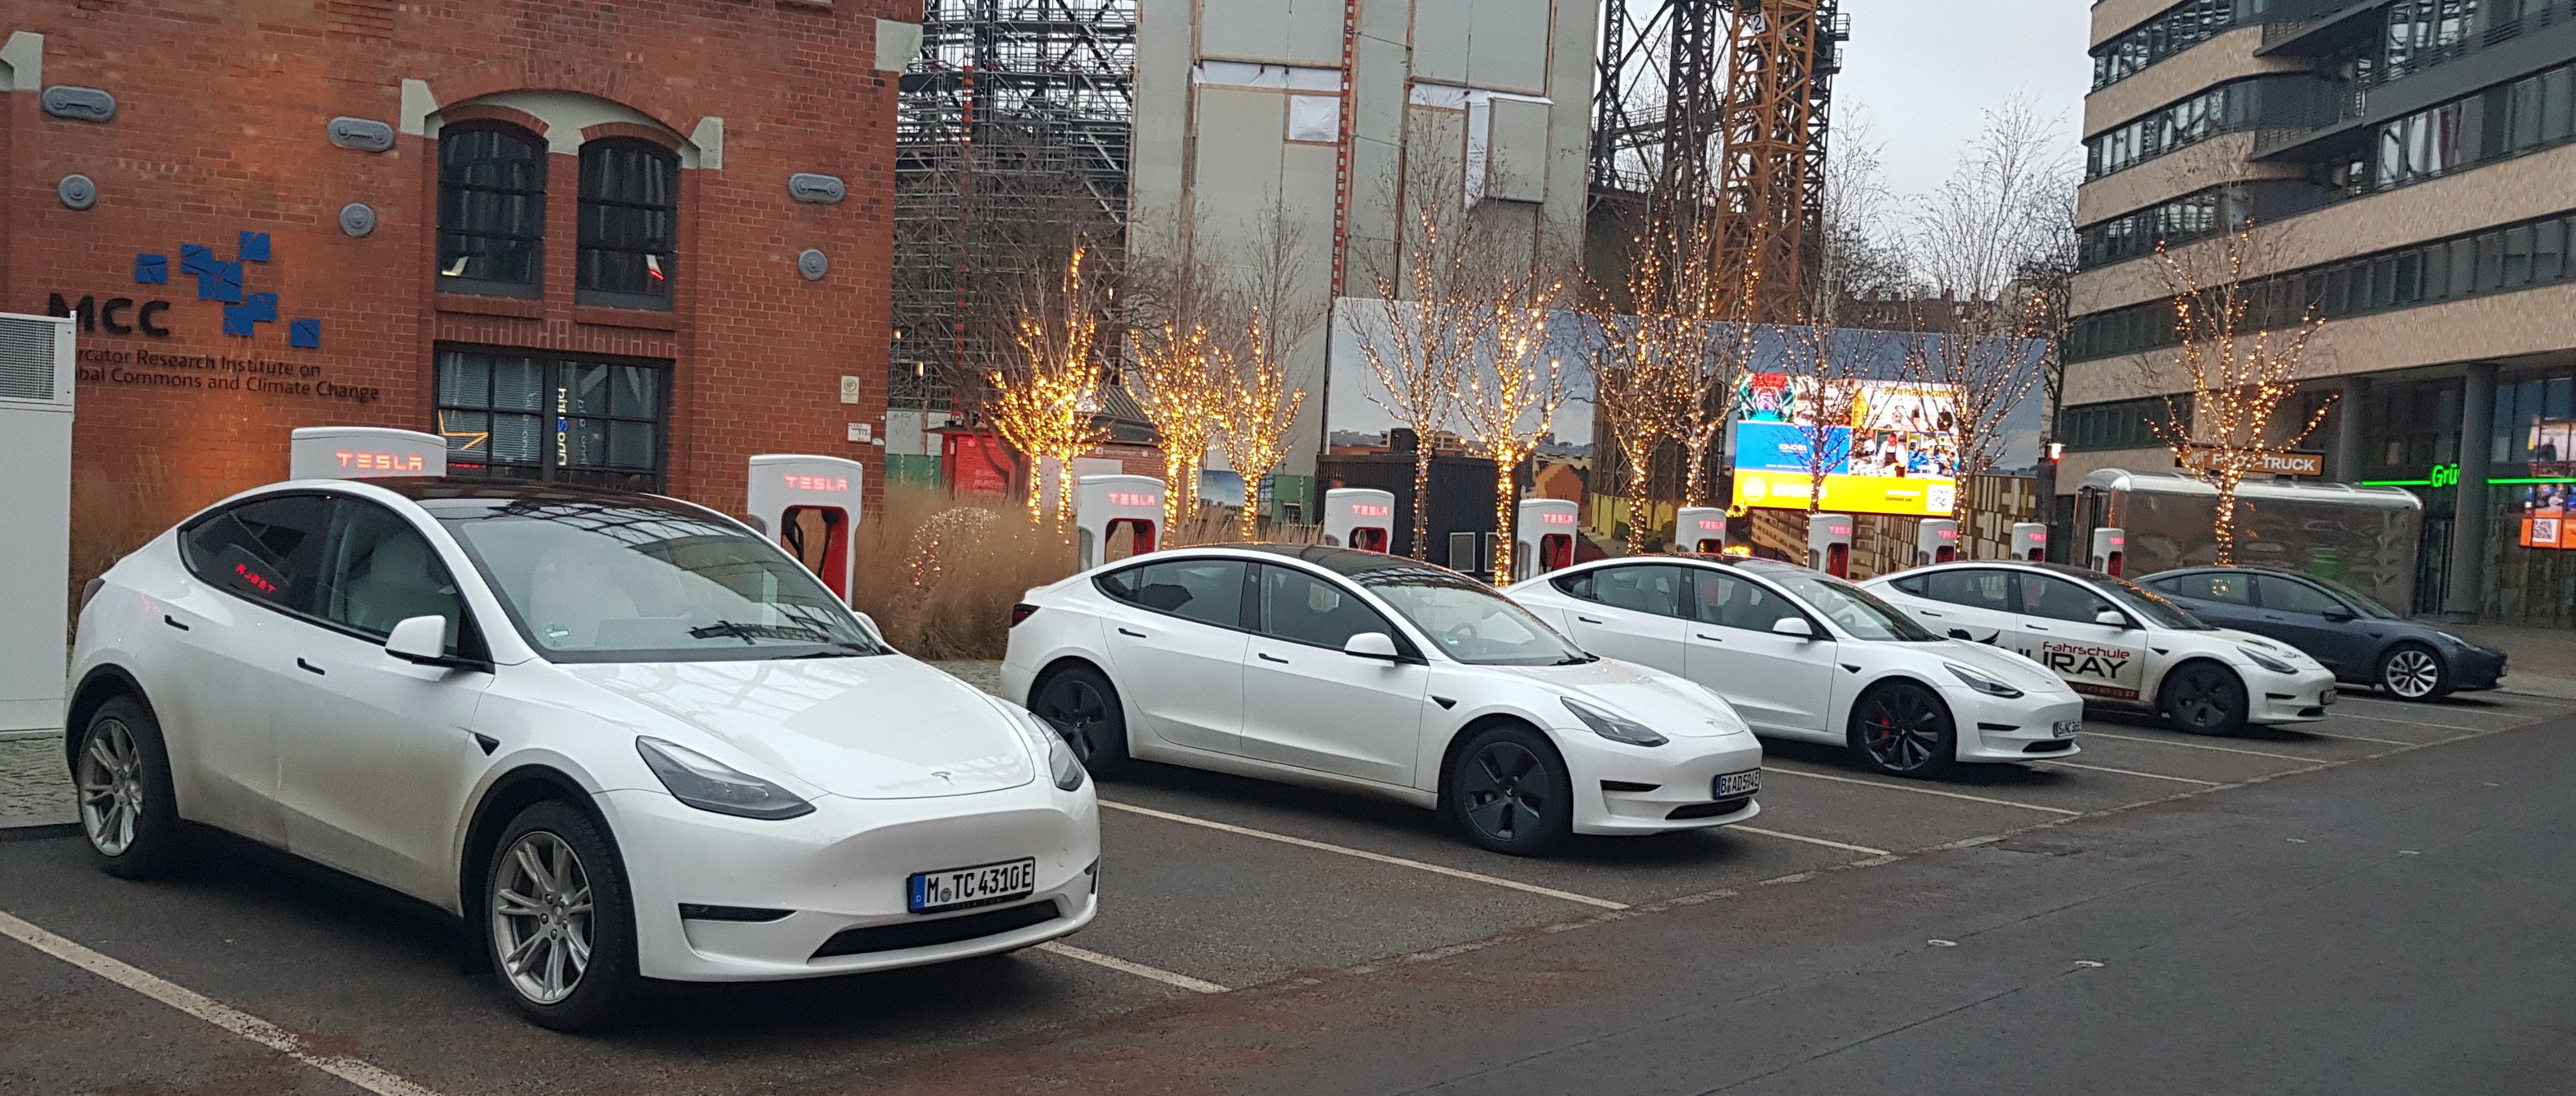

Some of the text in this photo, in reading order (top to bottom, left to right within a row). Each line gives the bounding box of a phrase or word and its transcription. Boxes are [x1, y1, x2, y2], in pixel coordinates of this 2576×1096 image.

[1753, 15, 1762, 30] 2
[48, 292, 171, 337] MCC
[77, 348, 320, 377] rcator Research Institute on
[112, 367, 202, 387] Commons
[208, 376, 240, 390] and
[247, 377, 311, 395] Climate
[317, 381, 379, 404] Change
[336, 452, 423, 471] TESLA
[783, 474, 849, 492] TESLA
[2432, 463, 2460, 488] Grü
[1108, 492, 1155, 506] TESLA
[1352, 503, 1389, 516] TESLA
[1543, 512, 1574, 525] TESLA
[2043, 641, 2130, 659] Fahrschule
[2018, 647, 2130, 679] URAY
[1721, 777, 1727, 794] B
[927, 877, 940, 903] M
[952, 873, 975, 900] TC
